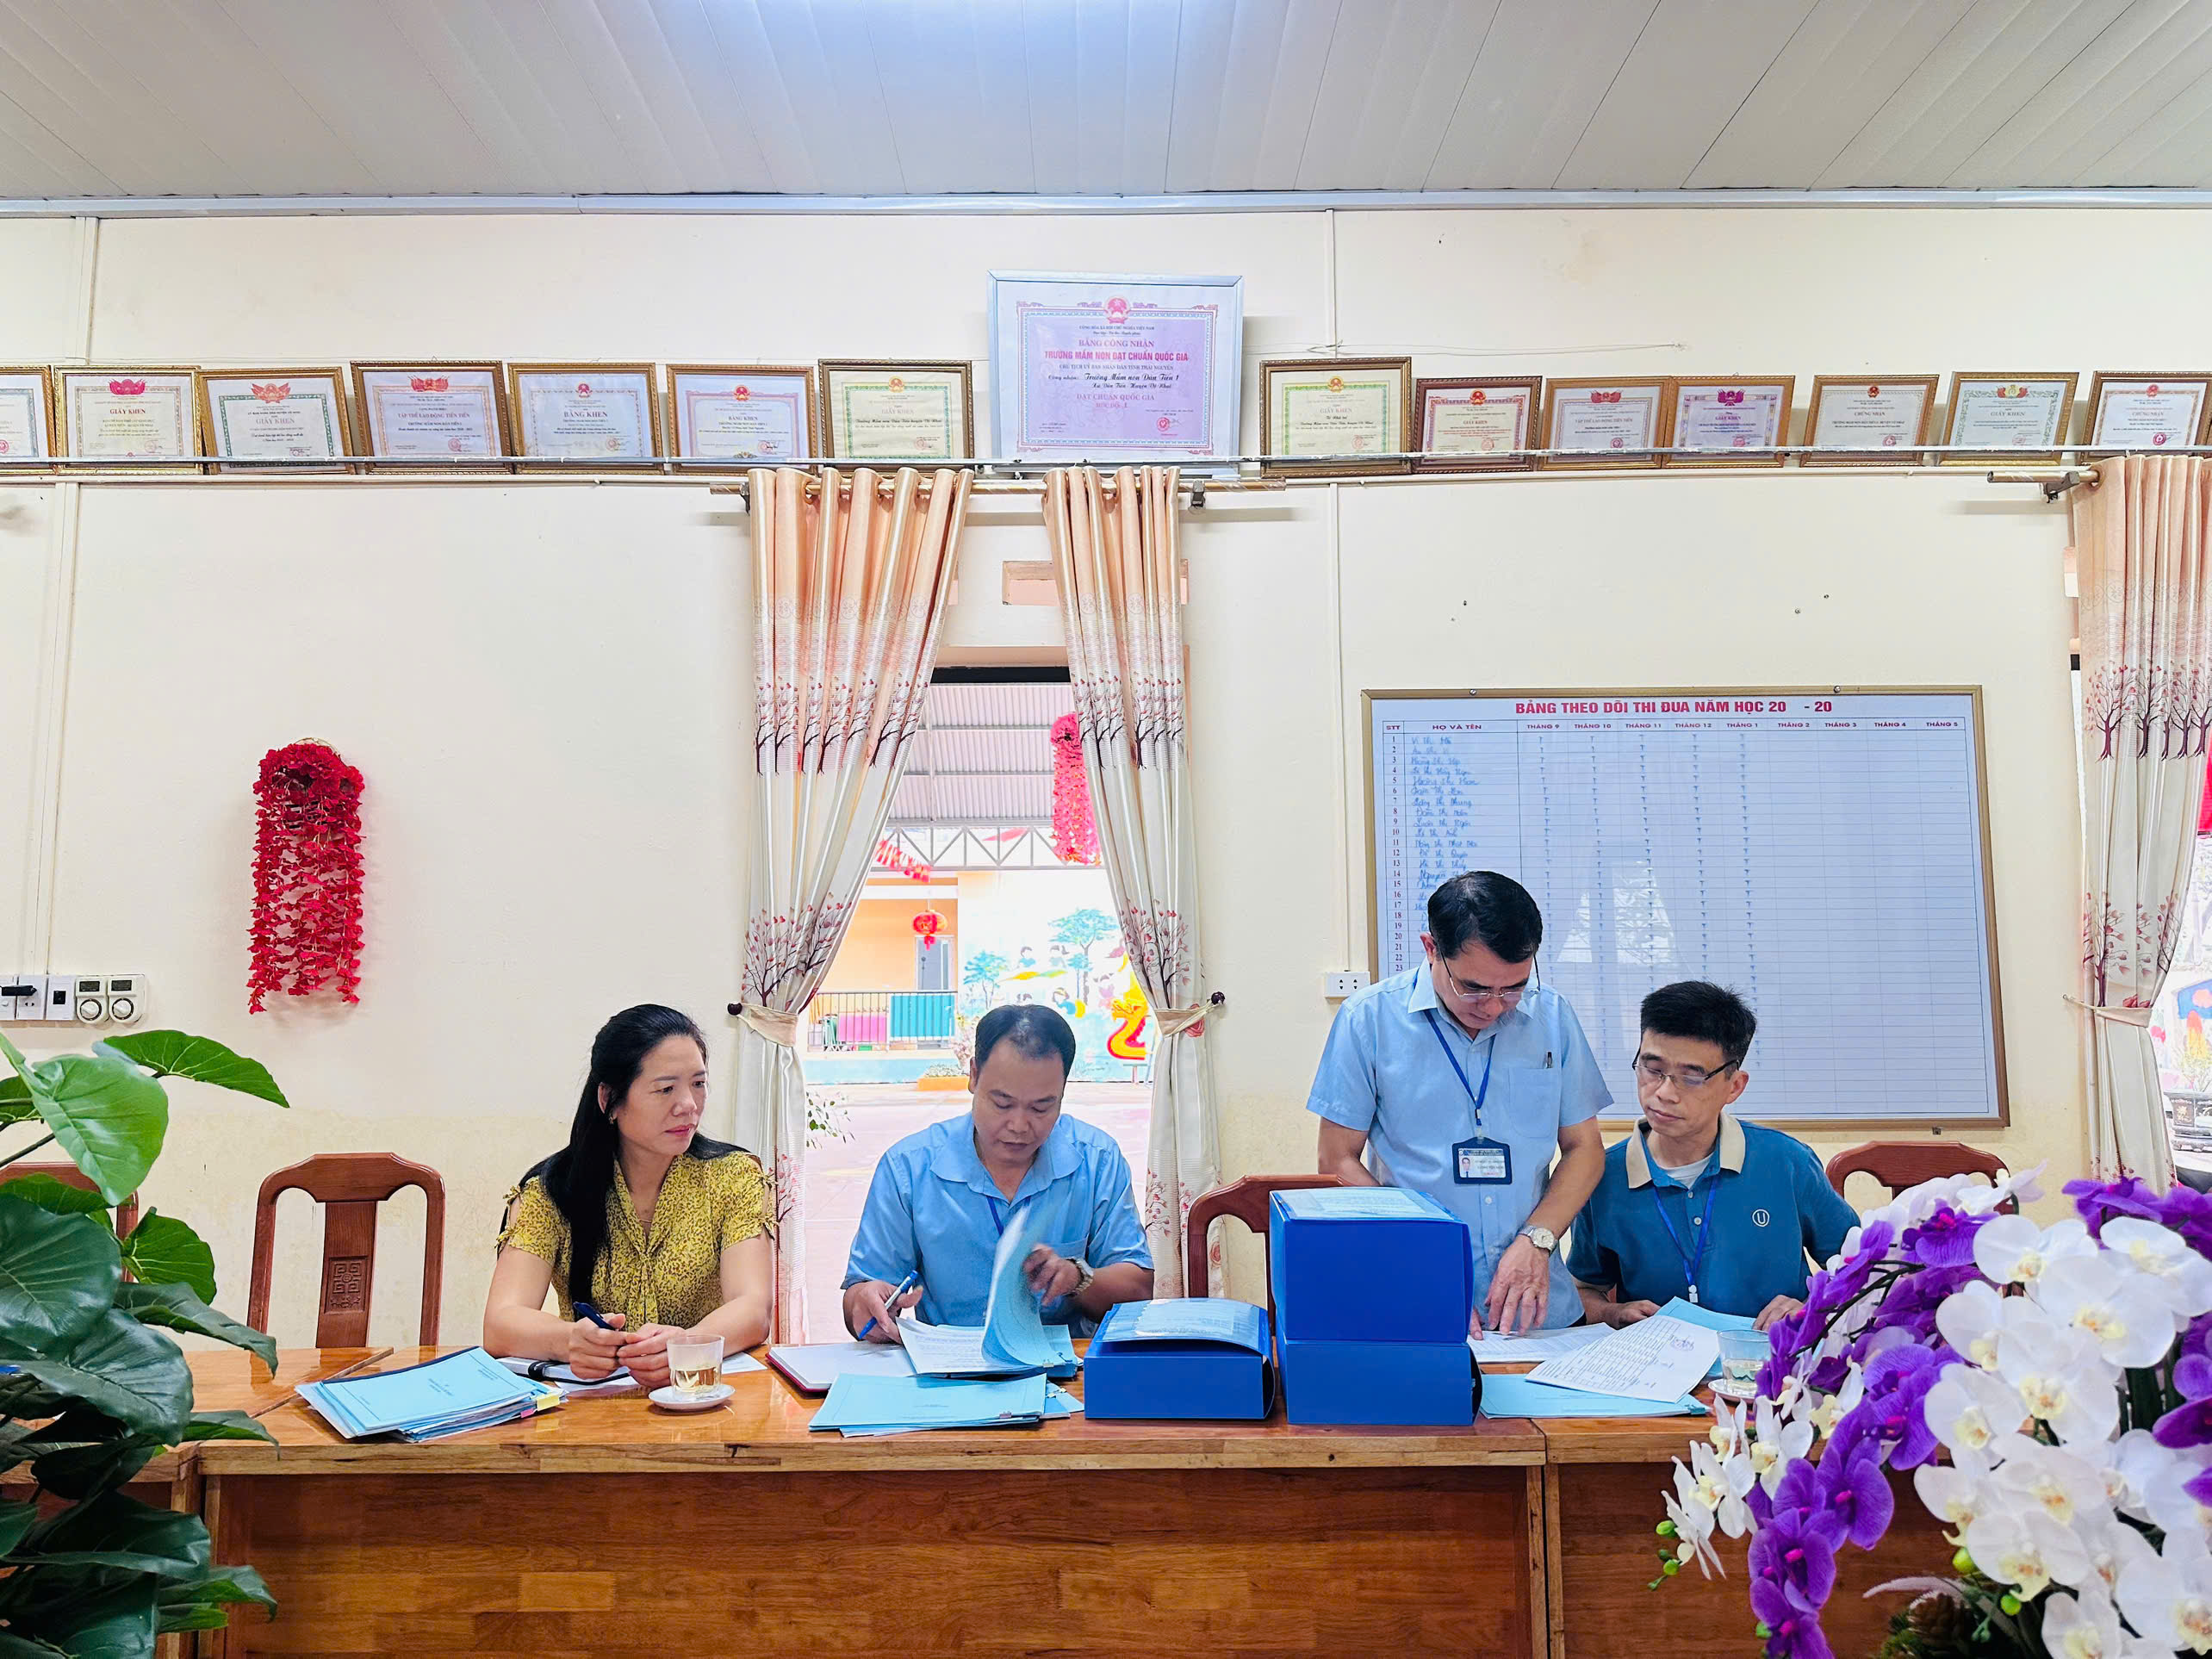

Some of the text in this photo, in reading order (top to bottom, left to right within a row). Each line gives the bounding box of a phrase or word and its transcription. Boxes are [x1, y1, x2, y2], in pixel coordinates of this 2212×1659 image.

[1104, 339, 1128, 347] CÔNG
[1130, 339, 1154, 348] NHẬN
[1096, 351, 1111, 360] NON
[1155, 350, 1174, 361] QUỐC
[1176, 353, 1188, 361] GIA
[1120, 392, 1140, 401] QUỐC
[1516, 699, 1556, 714] BẢNG
[1561, 702, 1598, 713] THEO
[1603, 700, 1628, 713] DÕI
[1633, 702, 1656, 713] THI
[1661, 702, 1690, 712] ĐUA
[1695, 699, 1729, 712] NĂM
[1734, 701, 1764, 715] HỌC
[1768, 701, 1786, 712] 20
[1814, 701, 1832, 712] 20
